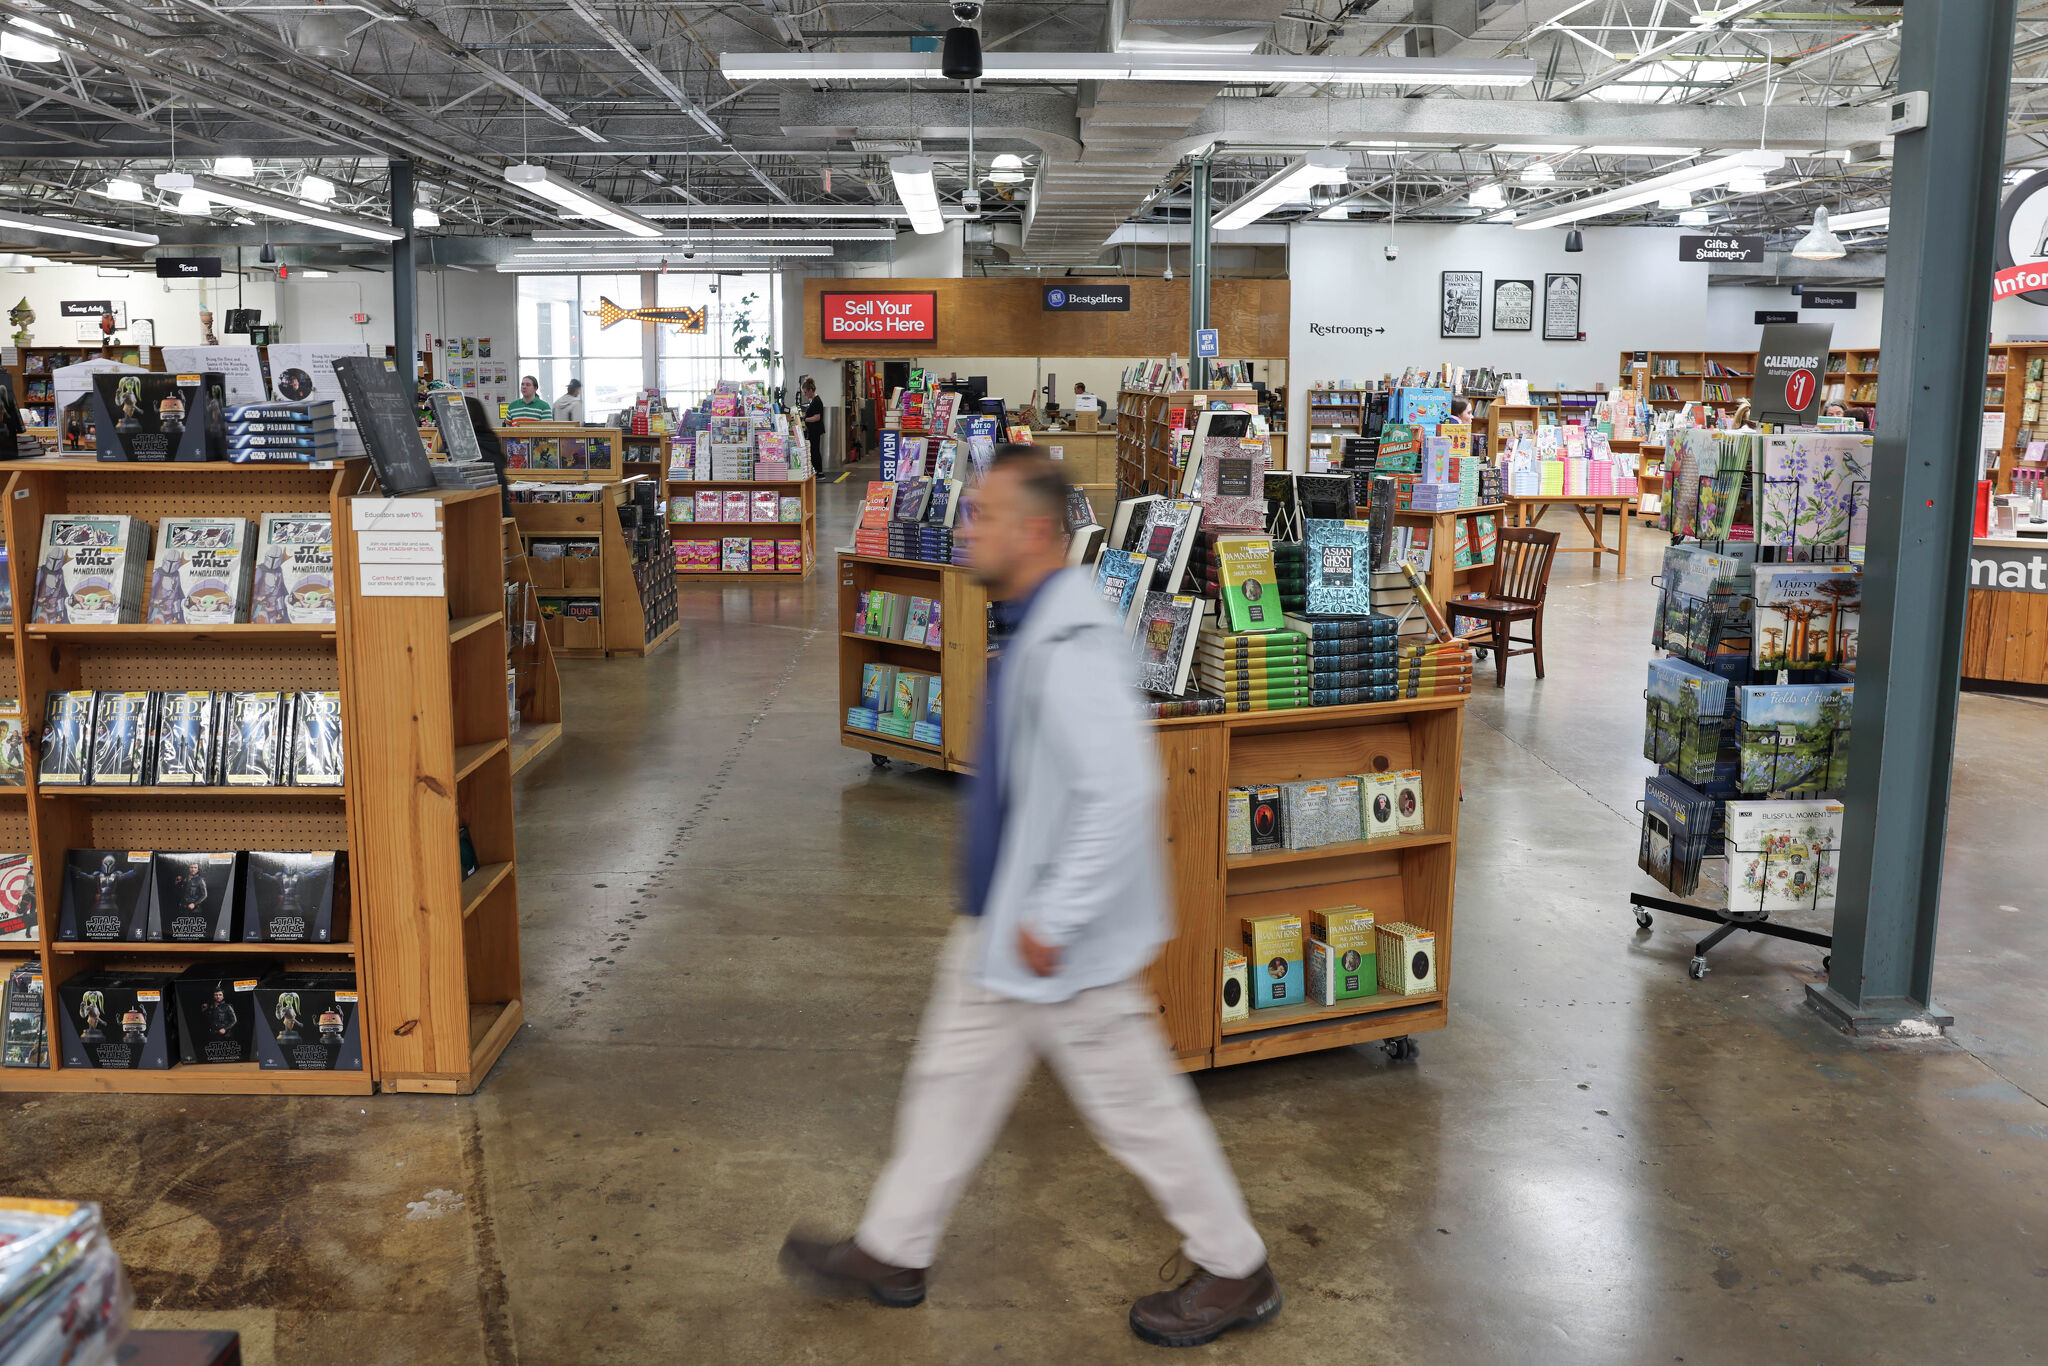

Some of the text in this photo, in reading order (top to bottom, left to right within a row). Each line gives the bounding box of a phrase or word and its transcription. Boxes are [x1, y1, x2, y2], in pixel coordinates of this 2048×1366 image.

[1704, 239, 1739, 249] Gifts &
[1696, 248, 1750, 260] Stationery
[179, 263, 199, 272] Teen
[1069, 294, 1123, 305] Bestsellers
[1814, 297, 1843, 305] Business
[67, 304, 105, 313] Young Adul
[845, 300, 912, 315] Sell Your
[1766, 314, 1786, 322] Science
[833, 317, 925, 332] Books Here
[1309, 323, 1373, 337] Restrooms
[1764, 356, 1819, 368] CALENDARS
[1793, 373, 1807, 406] $1
[262, 410, 291, 418] PADAWAN
[883, 433, 895, 457] NEW
[1381, 442, 1413, 455] ANIMALS
[75, 548, 103, 556] STA
[192, 550, 216, 559] STA
[294, 546, 320, 554] STA
[294, 555, 332, 563] WARS
[1224, 552, 1269, 560] DAMNATIONS
[76, 557, 115, 565] WARS
[192, 559, 231, 568] WARS
[1323, 555, 1352, 567] GHOST
[73, 567, 114, 575] MANDALORIAN
[189, 569, 231, 577] MANDALORIAN
[292, 565, 333, 574] MANDALORIAN
[1776, 580, 1817, 589] MAJESTY
[1783, 588, 1810, 597] TREES
[1771, 691, 1840, 706] Fields of Home
[51, 701, 88, 715] JEDI
[1647, 783, 1686, 816] CAMPER VANS
[1796, 811, 1832, 819] MOMENTS
[86, 916, 121, 924] STAR
[172, 917, 206, 925] STAR
[270, 917, 304, 925] STAR
[86, 924, 120, 932] WARS
[172, 925, 206, 933] WARS
[270, 925, 304, 933] WARS
[1330, 922, 1373, 933] DAMNATIONS
[97, 1044, 131, 1052] STAR
[205, 1041, 241, 1050] STAR
[293, 1045, 327, 1053] STAR
[205, 1049, 240, 1057] WARS
[293, 1052, 328, 1060] WARS
